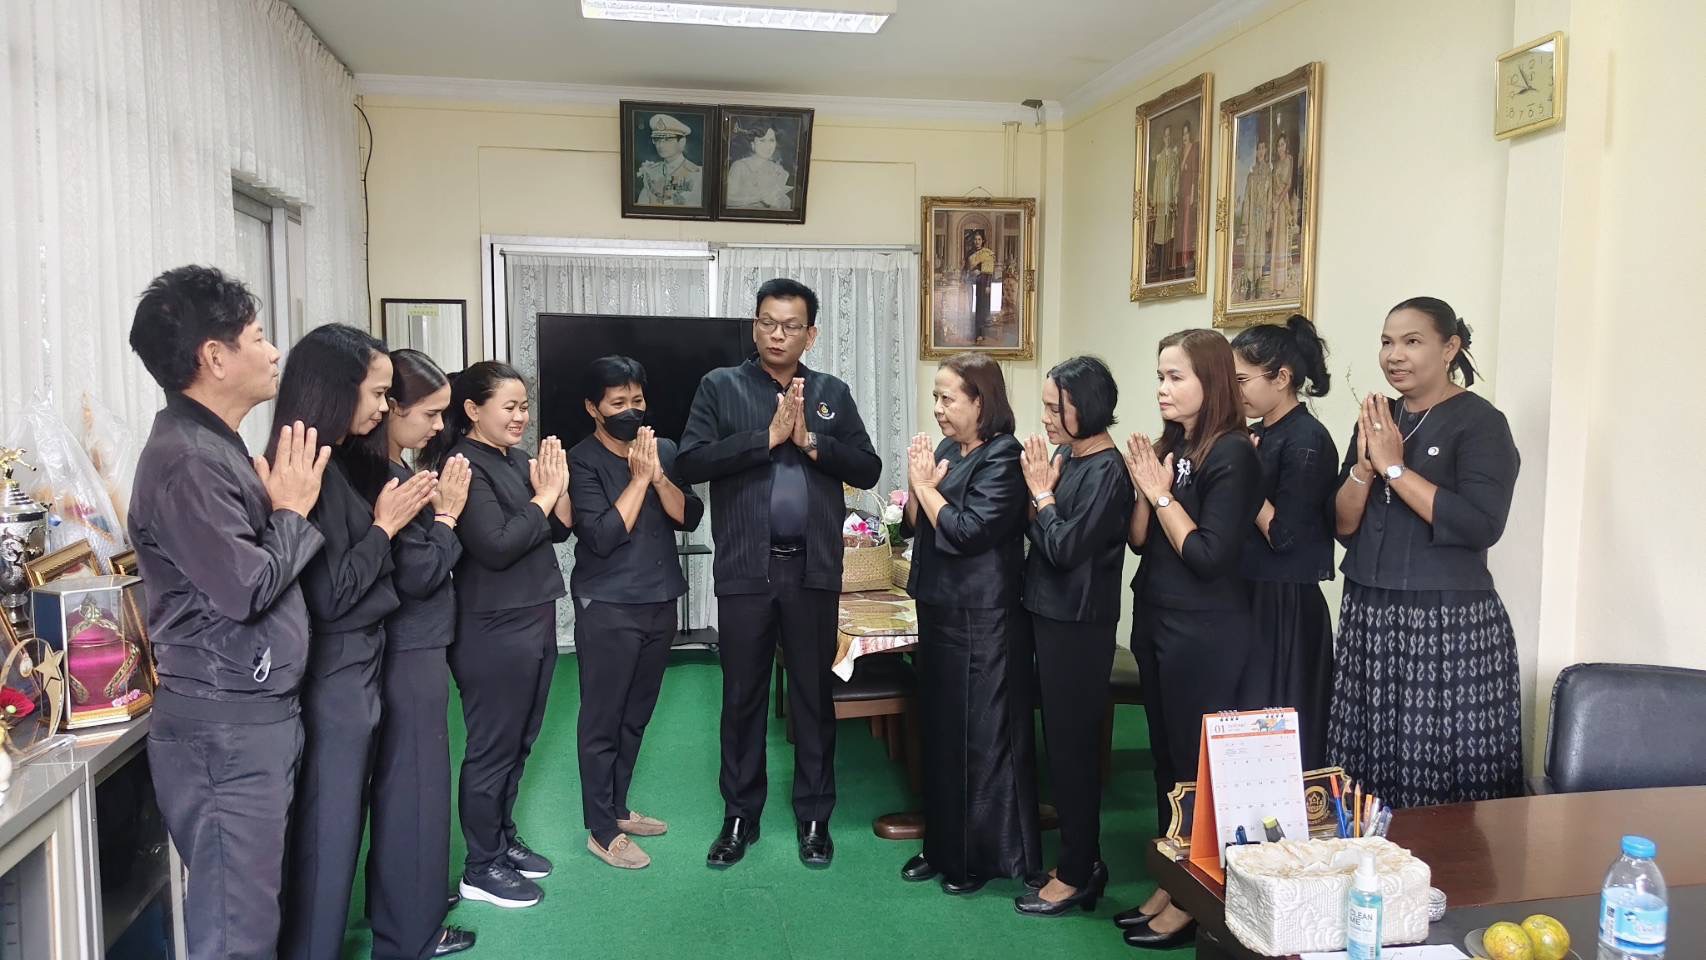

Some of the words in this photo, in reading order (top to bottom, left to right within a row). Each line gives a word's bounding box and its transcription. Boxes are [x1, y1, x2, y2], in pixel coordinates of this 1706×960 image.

[1214, 725, 1225, 733] 01
[1350, 908, 1373, 921] CLEAN
[1350, 915, 1361, 926] ME
